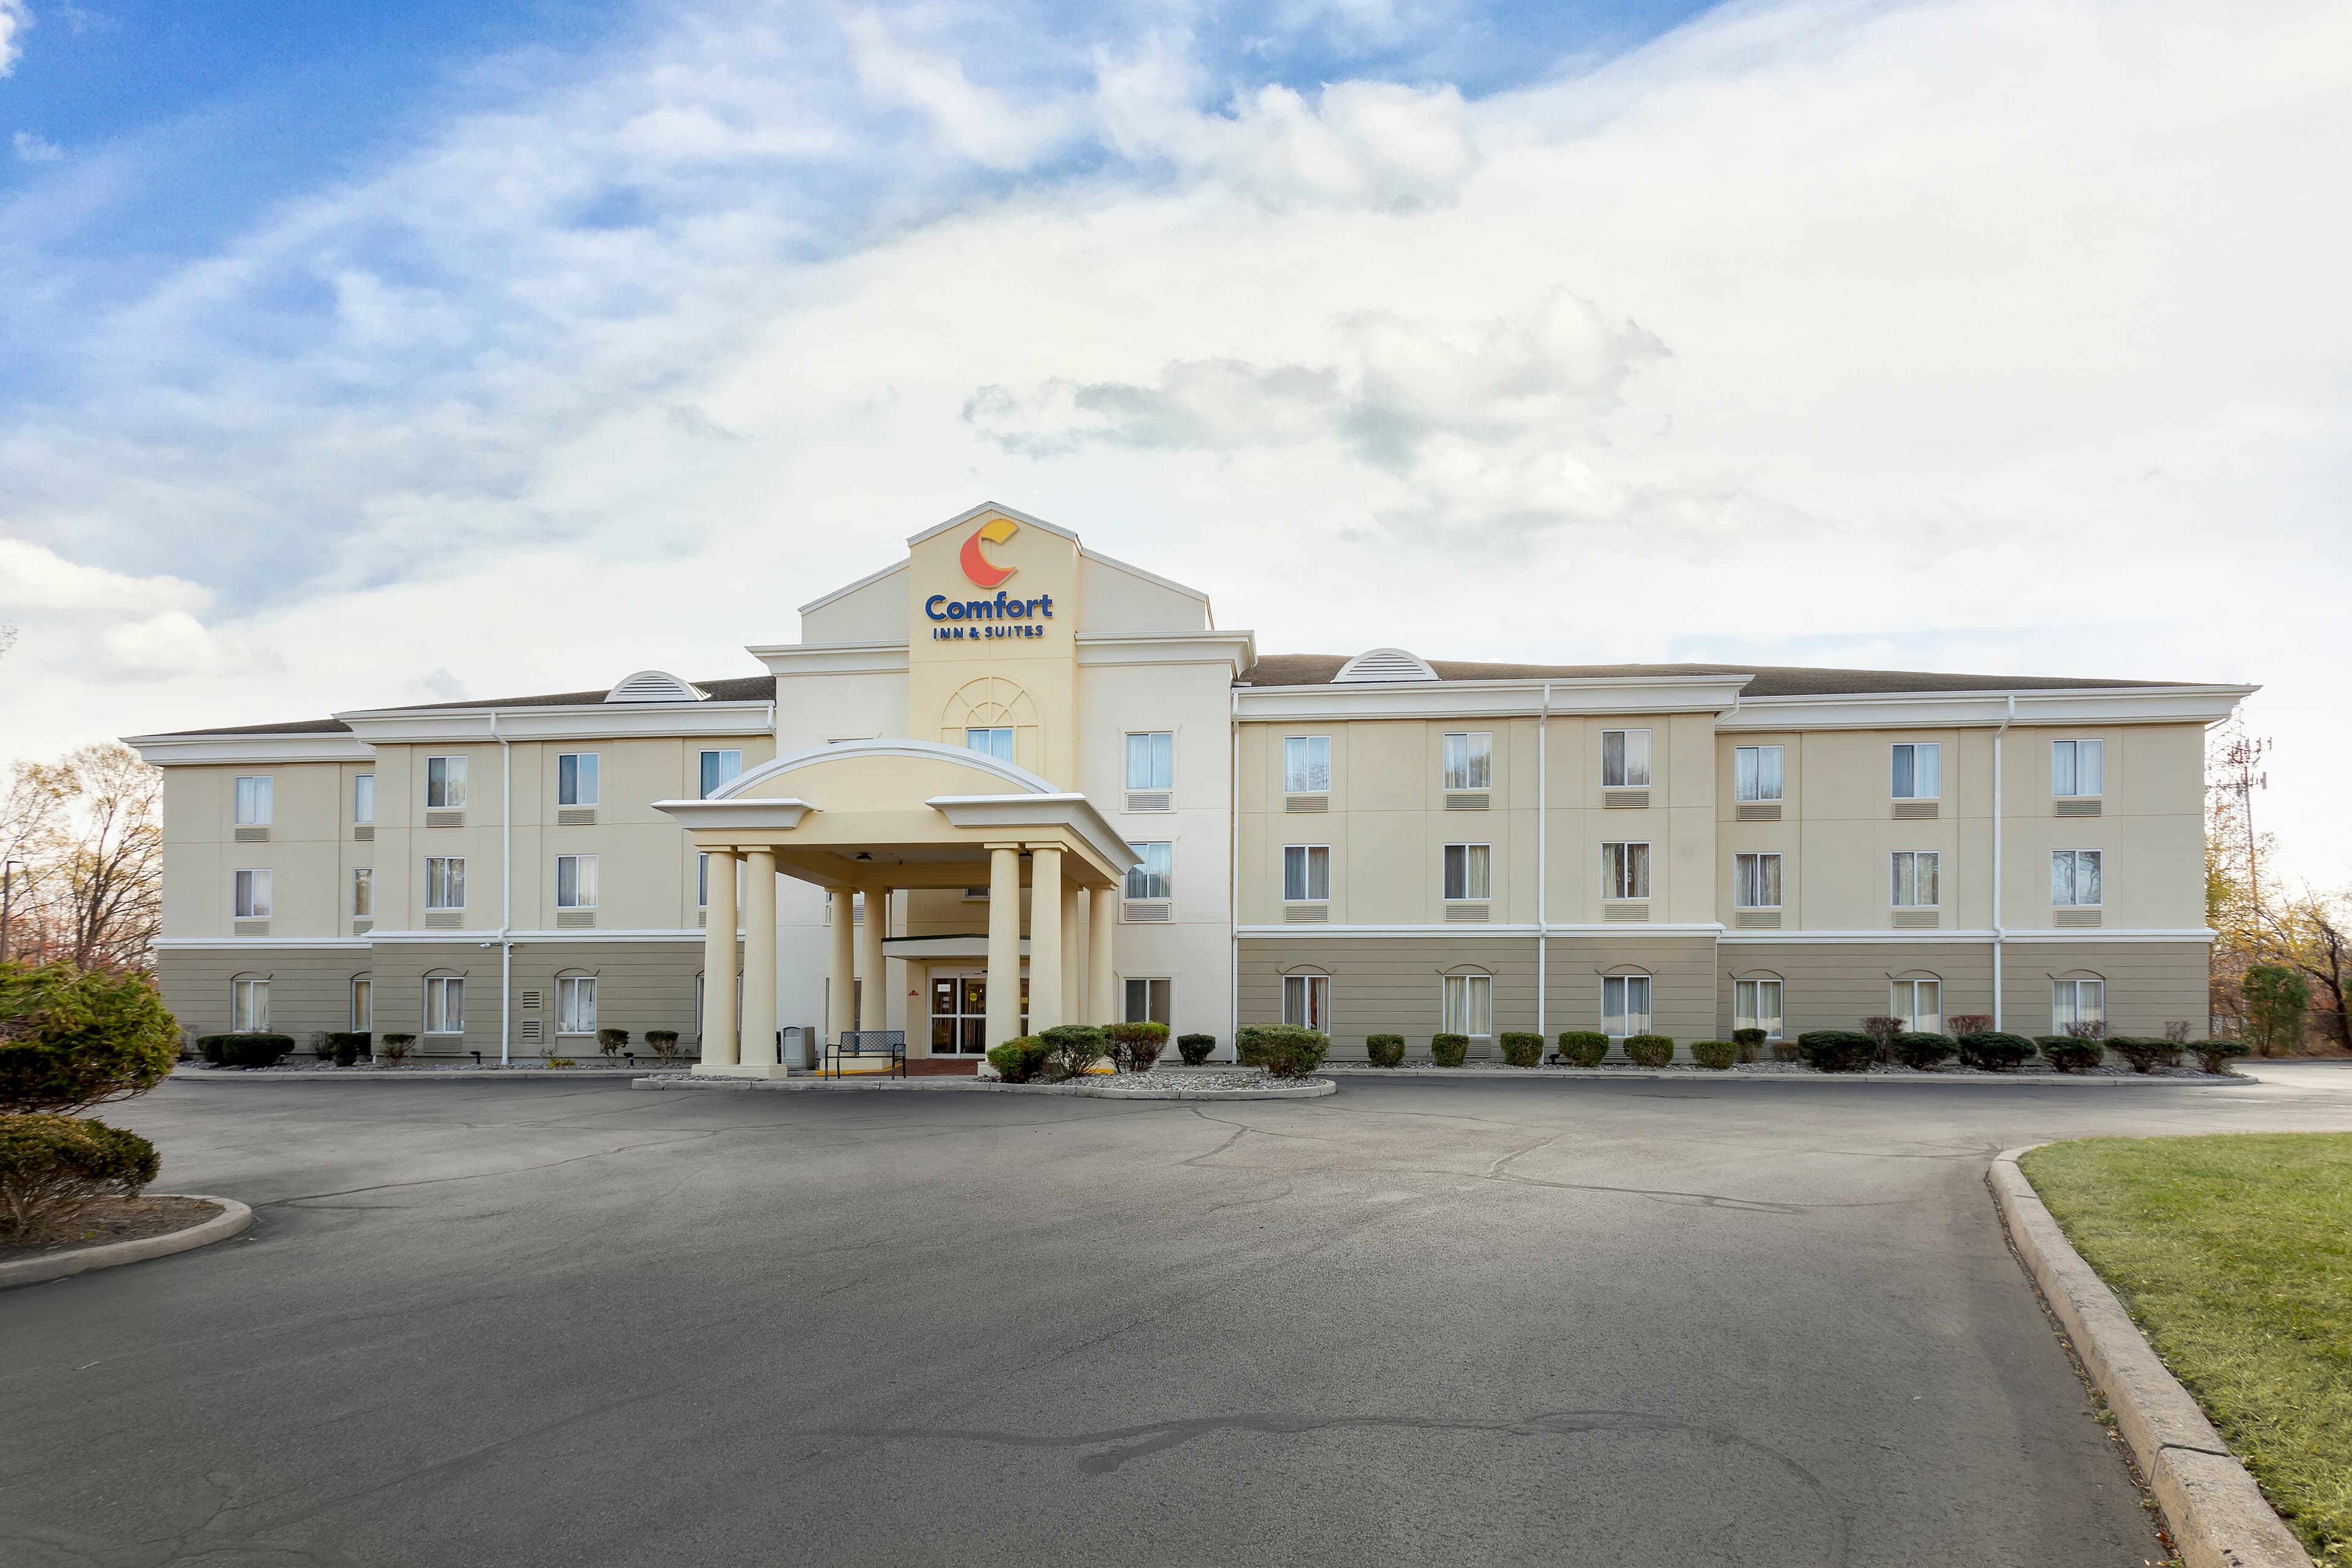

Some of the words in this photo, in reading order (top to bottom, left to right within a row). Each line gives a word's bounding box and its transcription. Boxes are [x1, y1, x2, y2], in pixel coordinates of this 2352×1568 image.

[925, 591, 1053, 620] Comfort
[933, 627, 964, 639] INN
[968, 627, 980, 638] &
[984, 625, 1044, 638] SUITES
